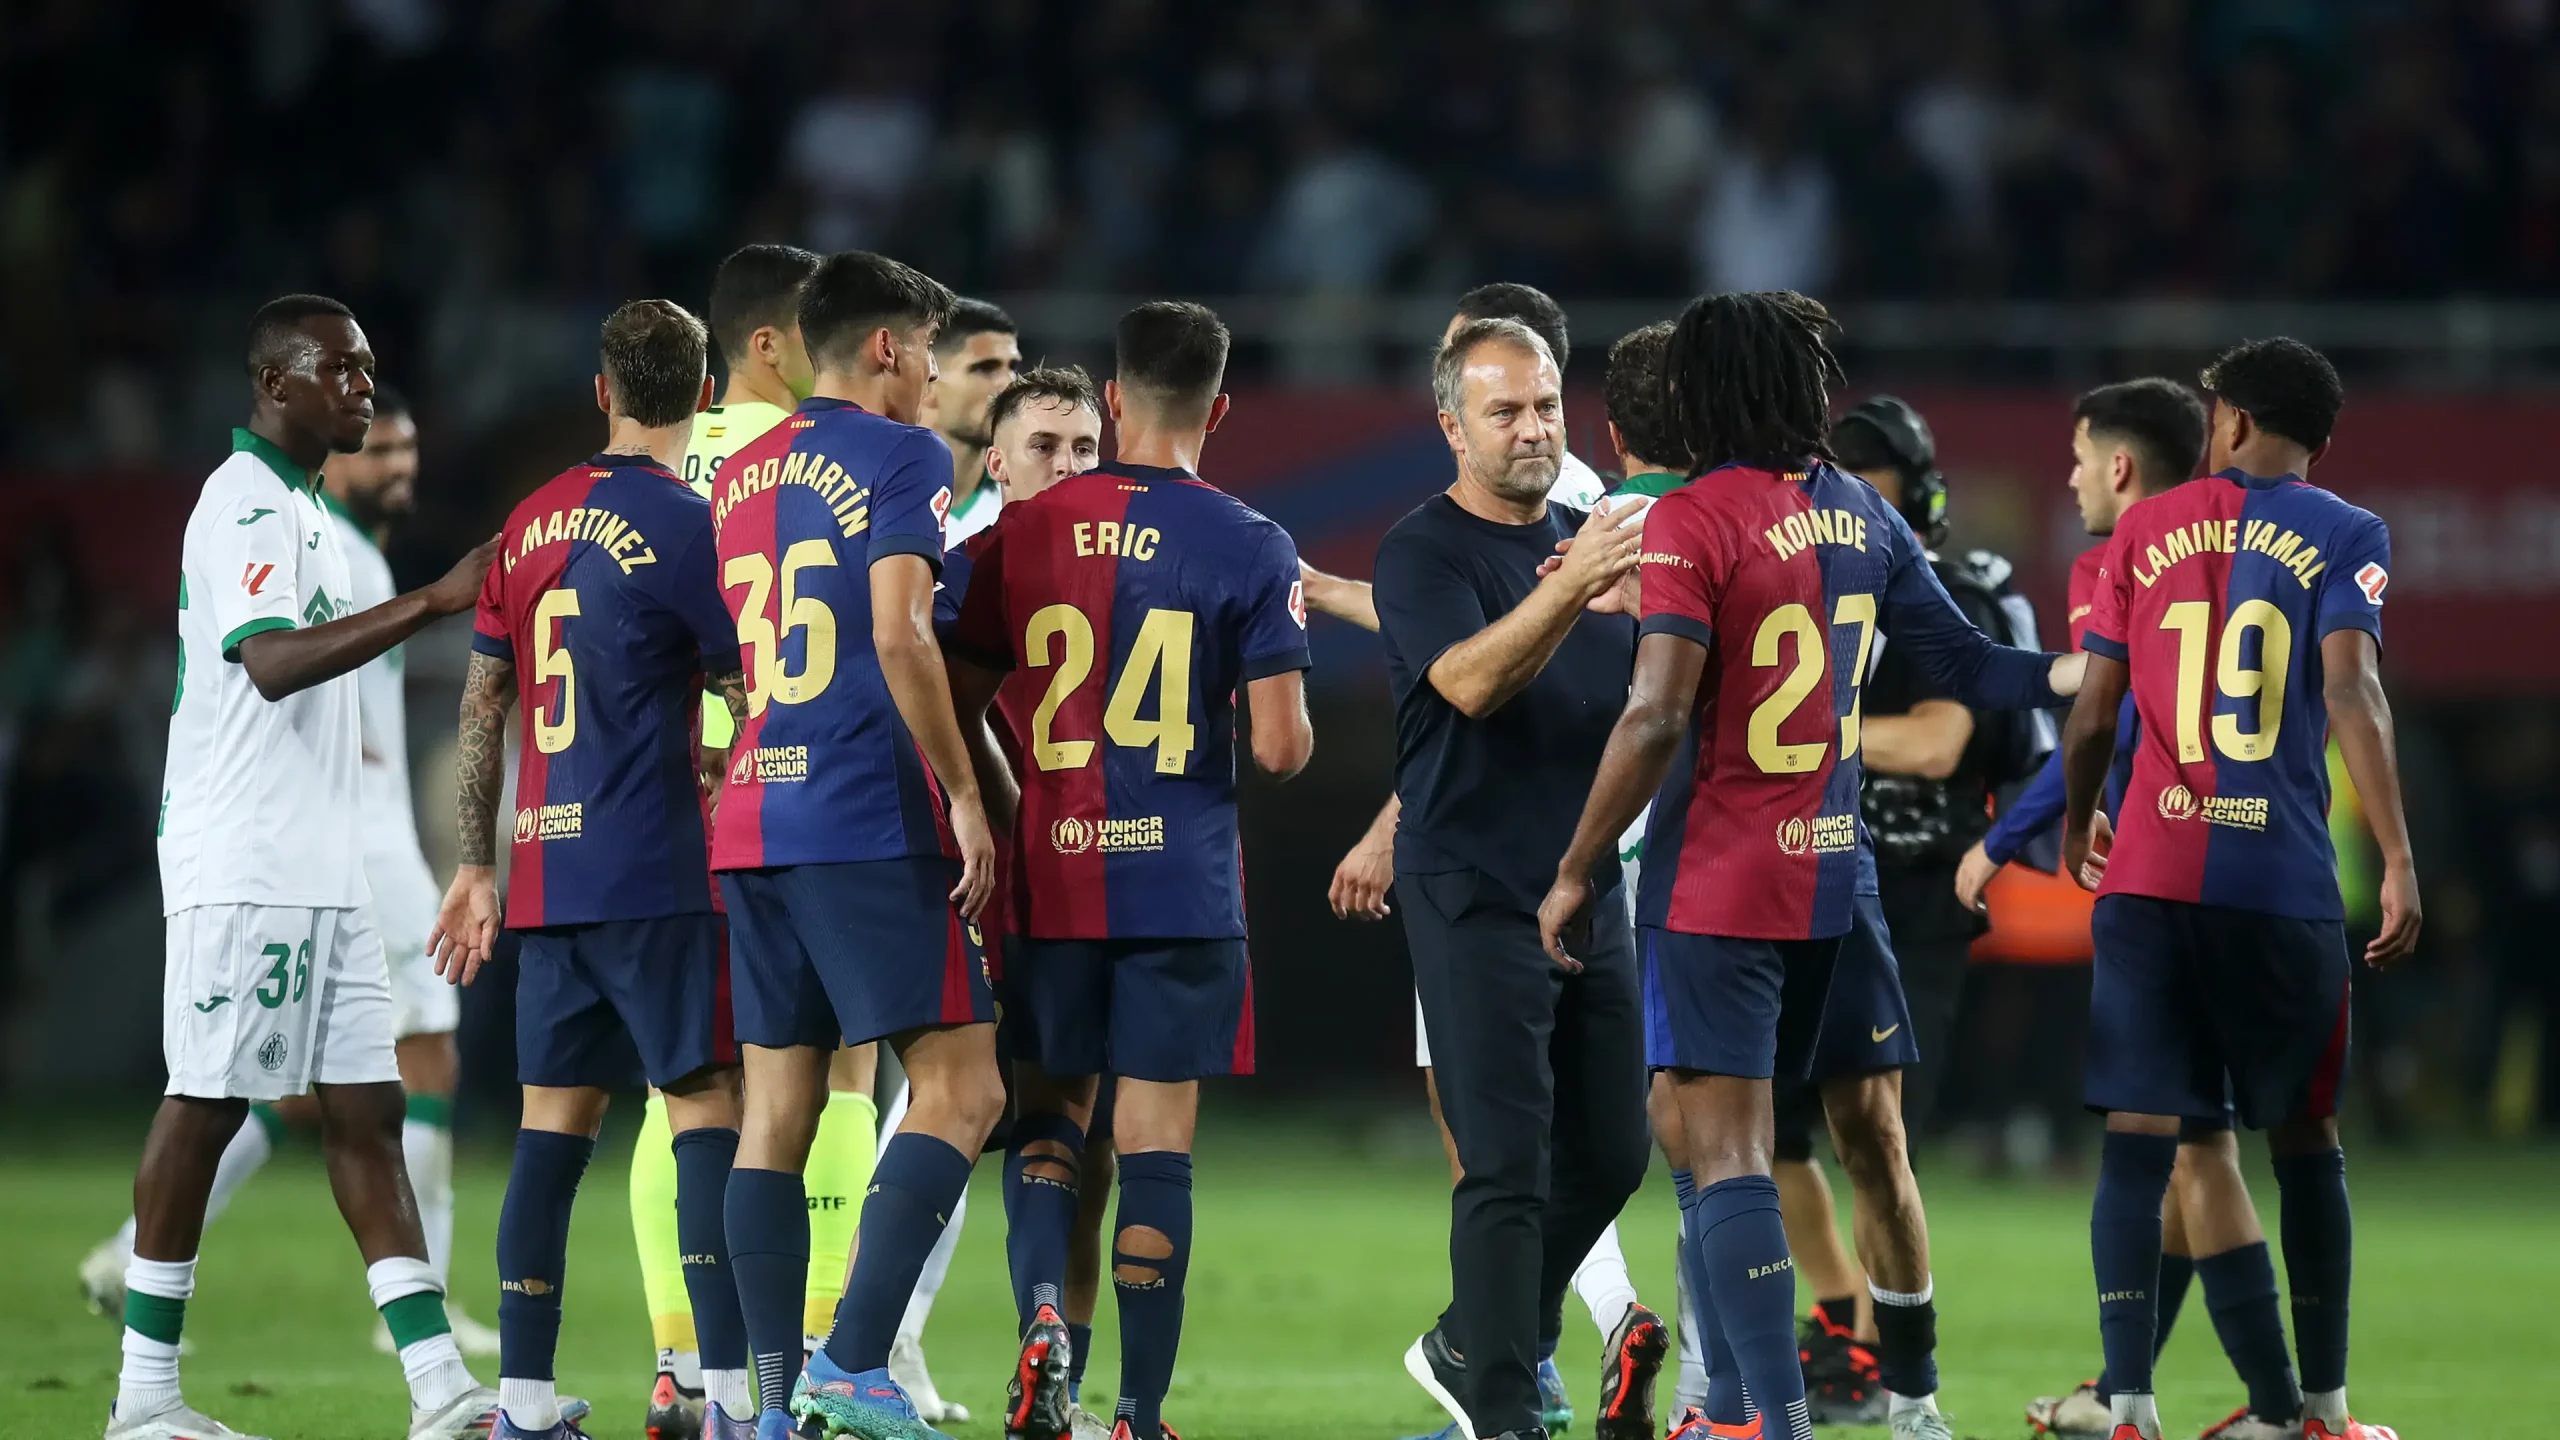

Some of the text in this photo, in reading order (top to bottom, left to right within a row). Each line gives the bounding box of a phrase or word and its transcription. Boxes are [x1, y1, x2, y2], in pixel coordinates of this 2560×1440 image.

[521, 508, 658, 575] MARTINEZ
[1073, 521, 1161, 562] ERIC
[2133, 519, 2238, 589] LAMINE
[2242, 519, 2327, 590] YAMAL
[724, 538, 839, 720] 35
[534, 588, 581, 754] 5
[1025, 603, 1195, 775] 24
[1747, 593, 1877, 774] 27
[2159, 599, 2292, 764] 19
[753, 745, 808, 762] UNHCR
[756, 760, 808, 777] ACNUR
[540, 803, 582, 820] UNHCR
[2203, 796, 2269, 812] UNHCR
[538, 817, 582, 834] ACNUR
[1097, 816, 1164, 834] UNHCR
[1812, 814, 1854, 832] UNHCR
[2200, 808, 2267, 826] ACNUR
[1096, 830, 1164, 847] ACNUR
[1811, 829, 1855, 847] ACNUR
[256, 939, 311, 1009] 36
